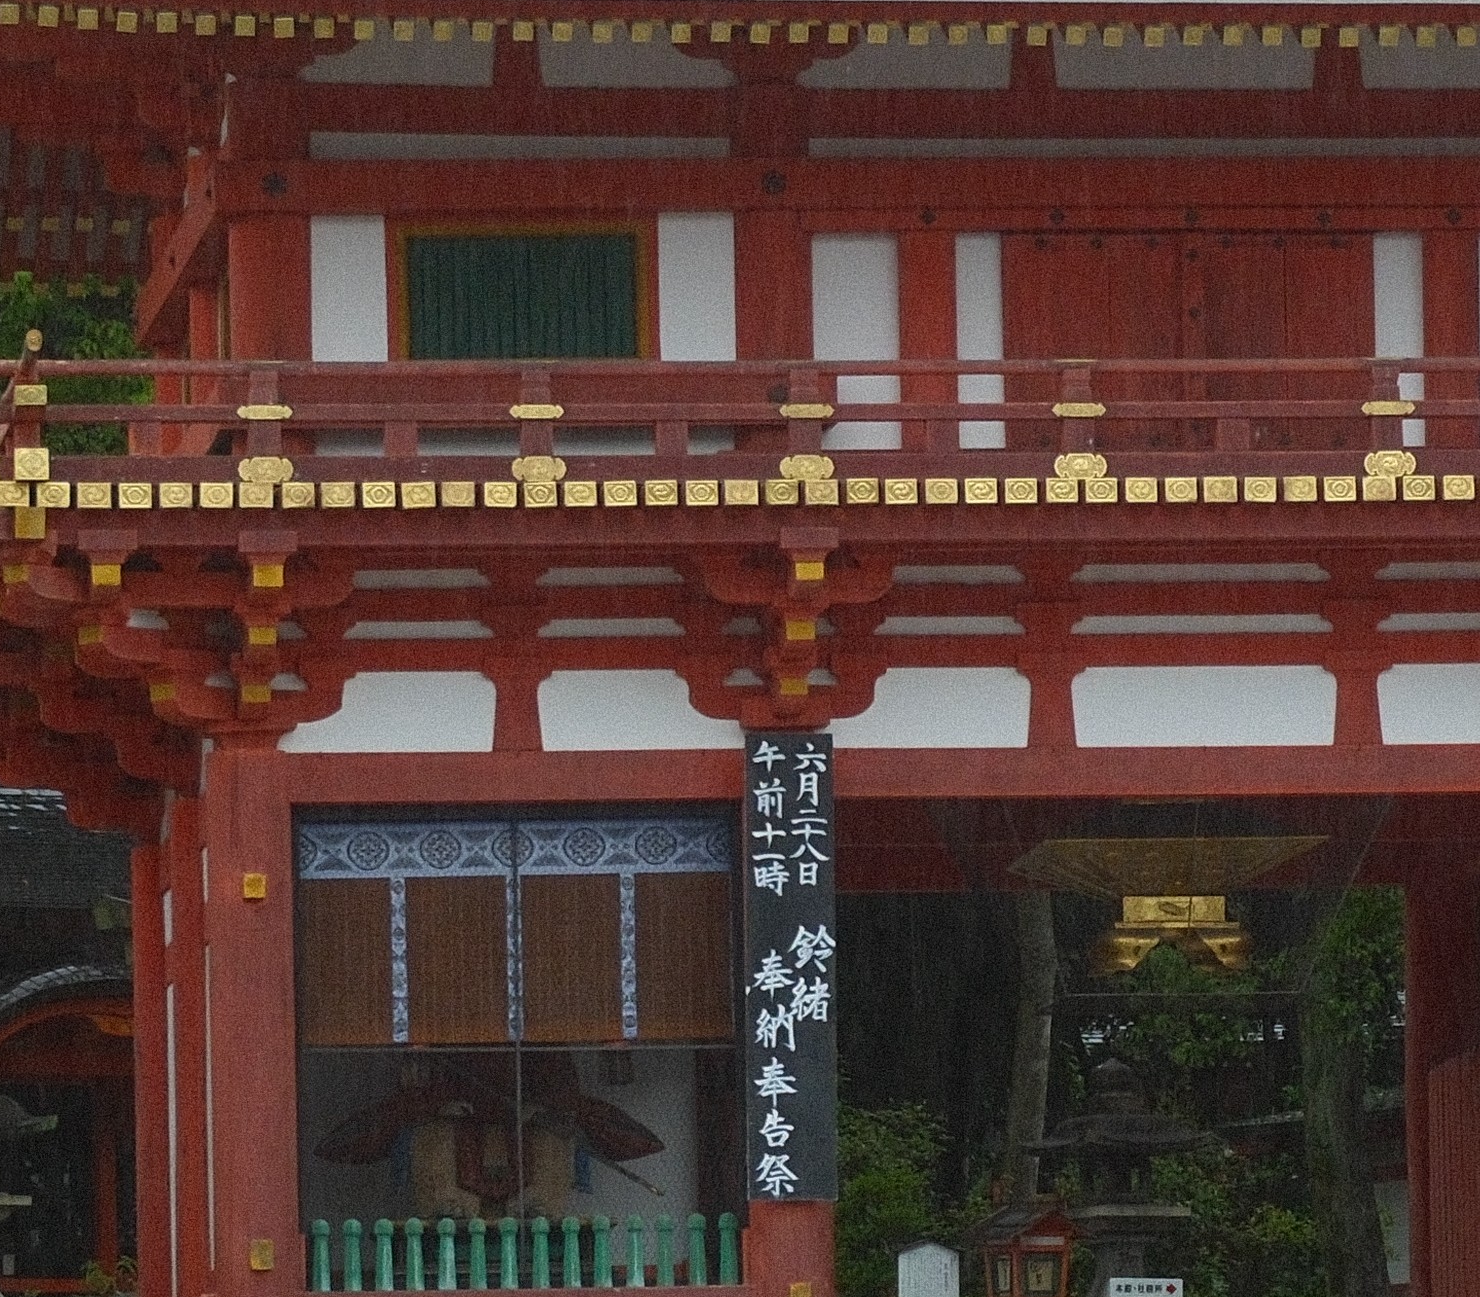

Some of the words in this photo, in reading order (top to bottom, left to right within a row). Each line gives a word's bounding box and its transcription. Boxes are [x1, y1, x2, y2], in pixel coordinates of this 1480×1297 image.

[751, 740, 789, 897] 午前十一時
[788, 742, 830, 887] 六月二十八日
[787, 923, 837, 1025] 鈴緒
[752, 948, 800, 1199] 奉納奉告祭
